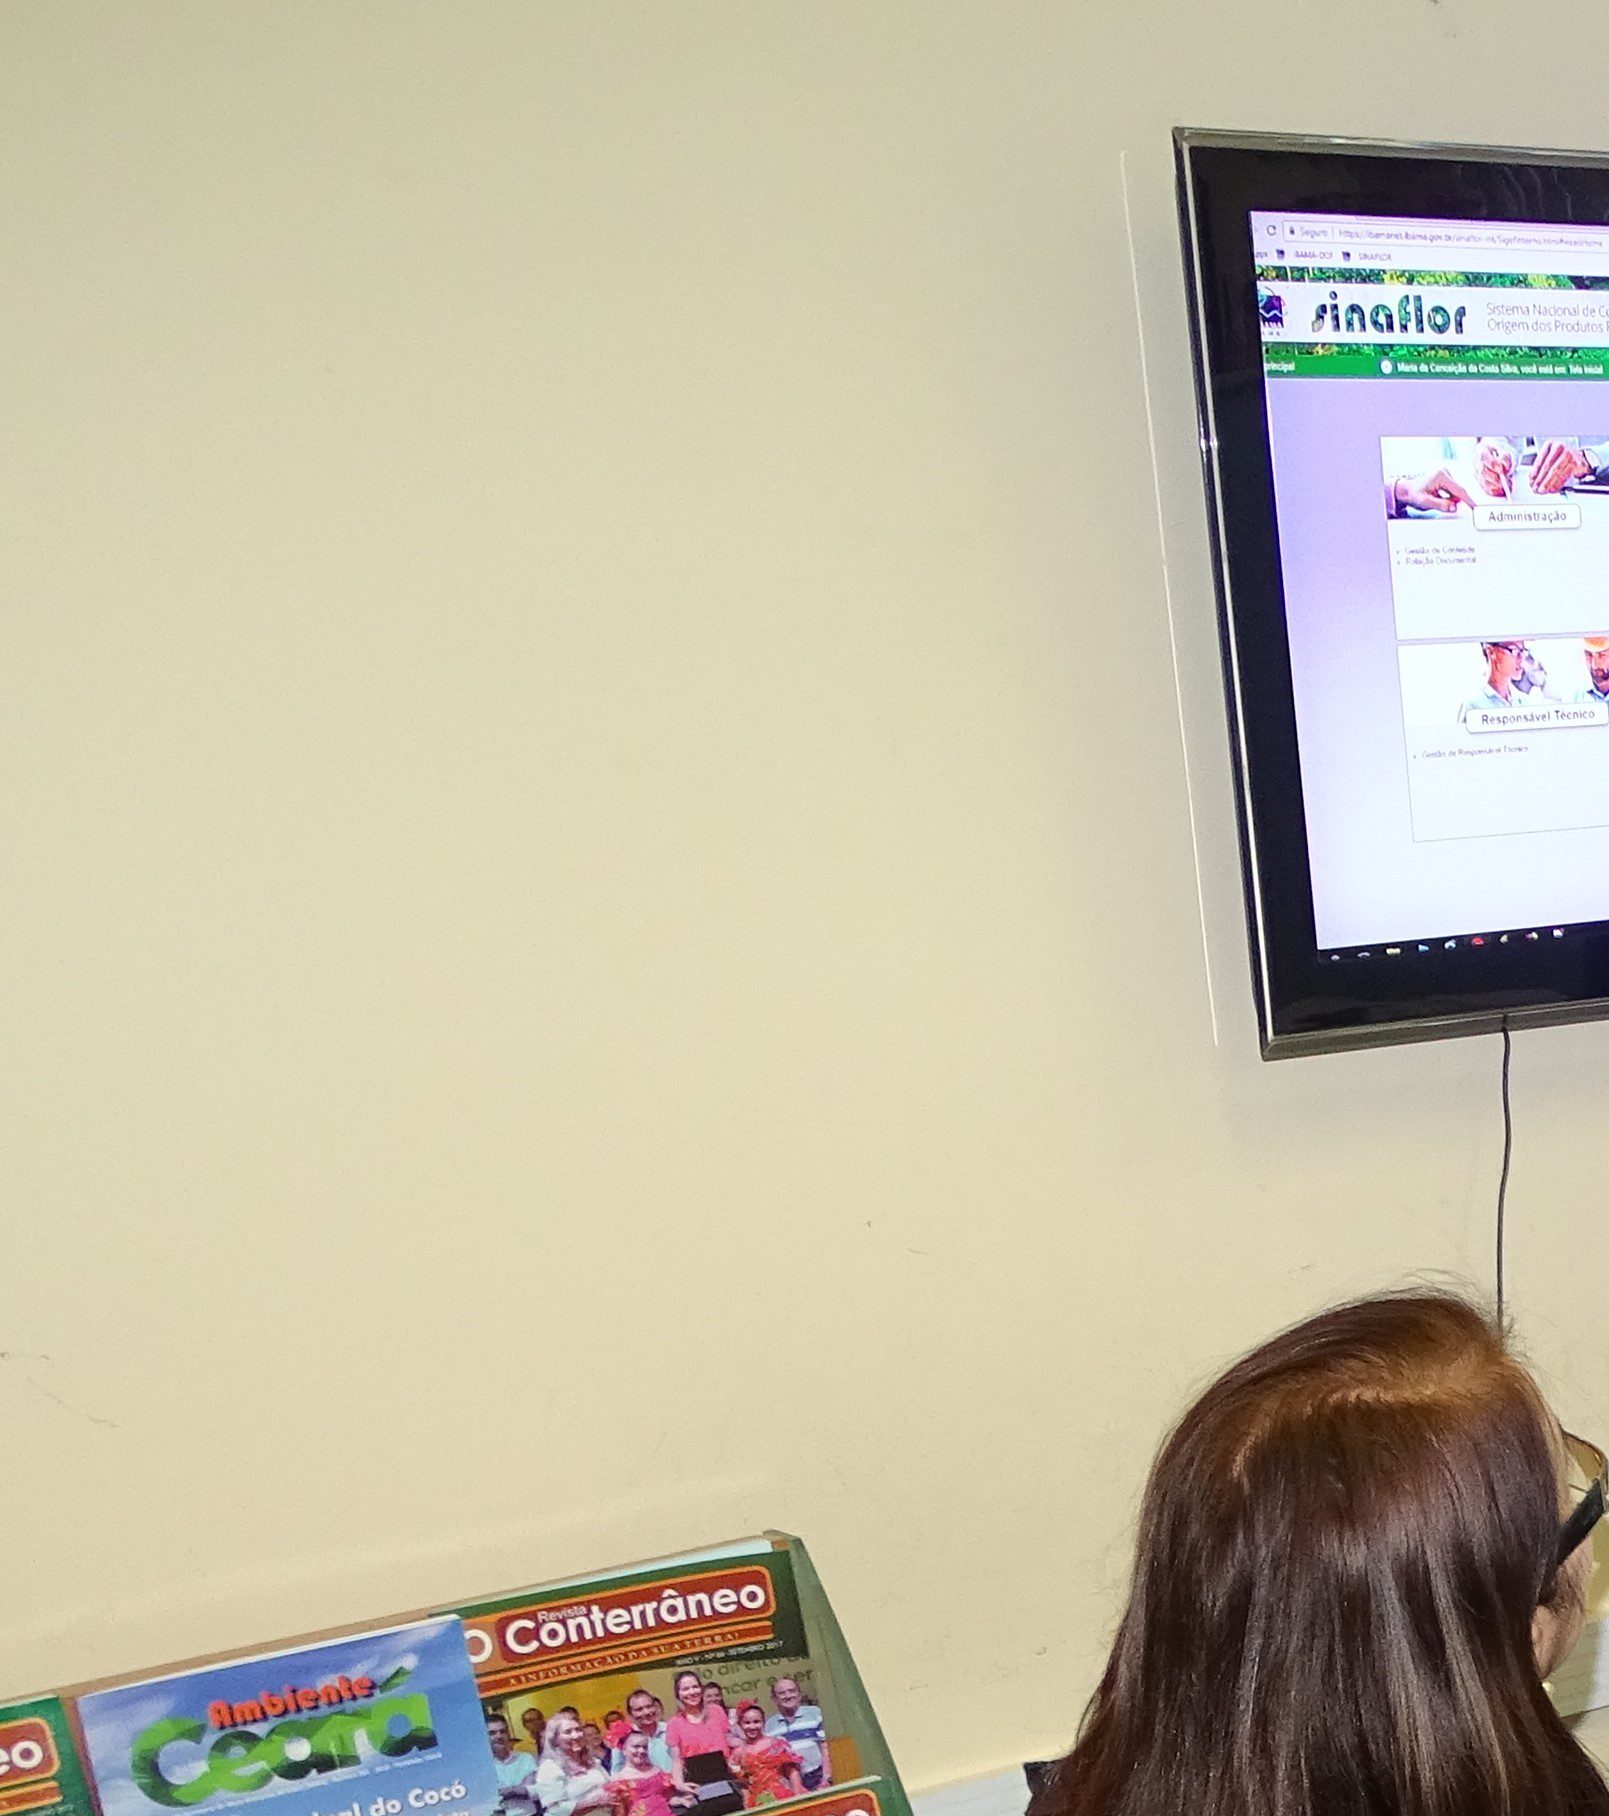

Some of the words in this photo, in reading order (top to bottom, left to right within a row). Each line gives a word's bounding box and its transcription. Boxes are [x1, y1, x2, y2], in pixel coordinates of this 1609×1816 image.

[1311, 291, 1466, 335] sinaflor
[1487, 303, 1529, 316] Sistema
[1533, 303, 1579, 317] Nacional
[1583, 305, 1595, 317] de
[1488, 318, 1529, 335] Origem
[1532, 319, 1551, 332] dos
[1554, 320, 1603, 333] Produtos
[1488, 510, 1567, 524] Administração
[1482, 710, 1551, 725] Responsável
[1554, 708, 1595, 720] Técnico
[504, 1584, 766, 1654] Conterrâneo
[537, 1604, 587, 1624] Revista
[466, 1629, 492, 1664] O
[208, 1675, 376, 1729] Ambiente
[130, 1665, 439, 1808] Ceará
[408, 1780, 468, 1809] Cocó
